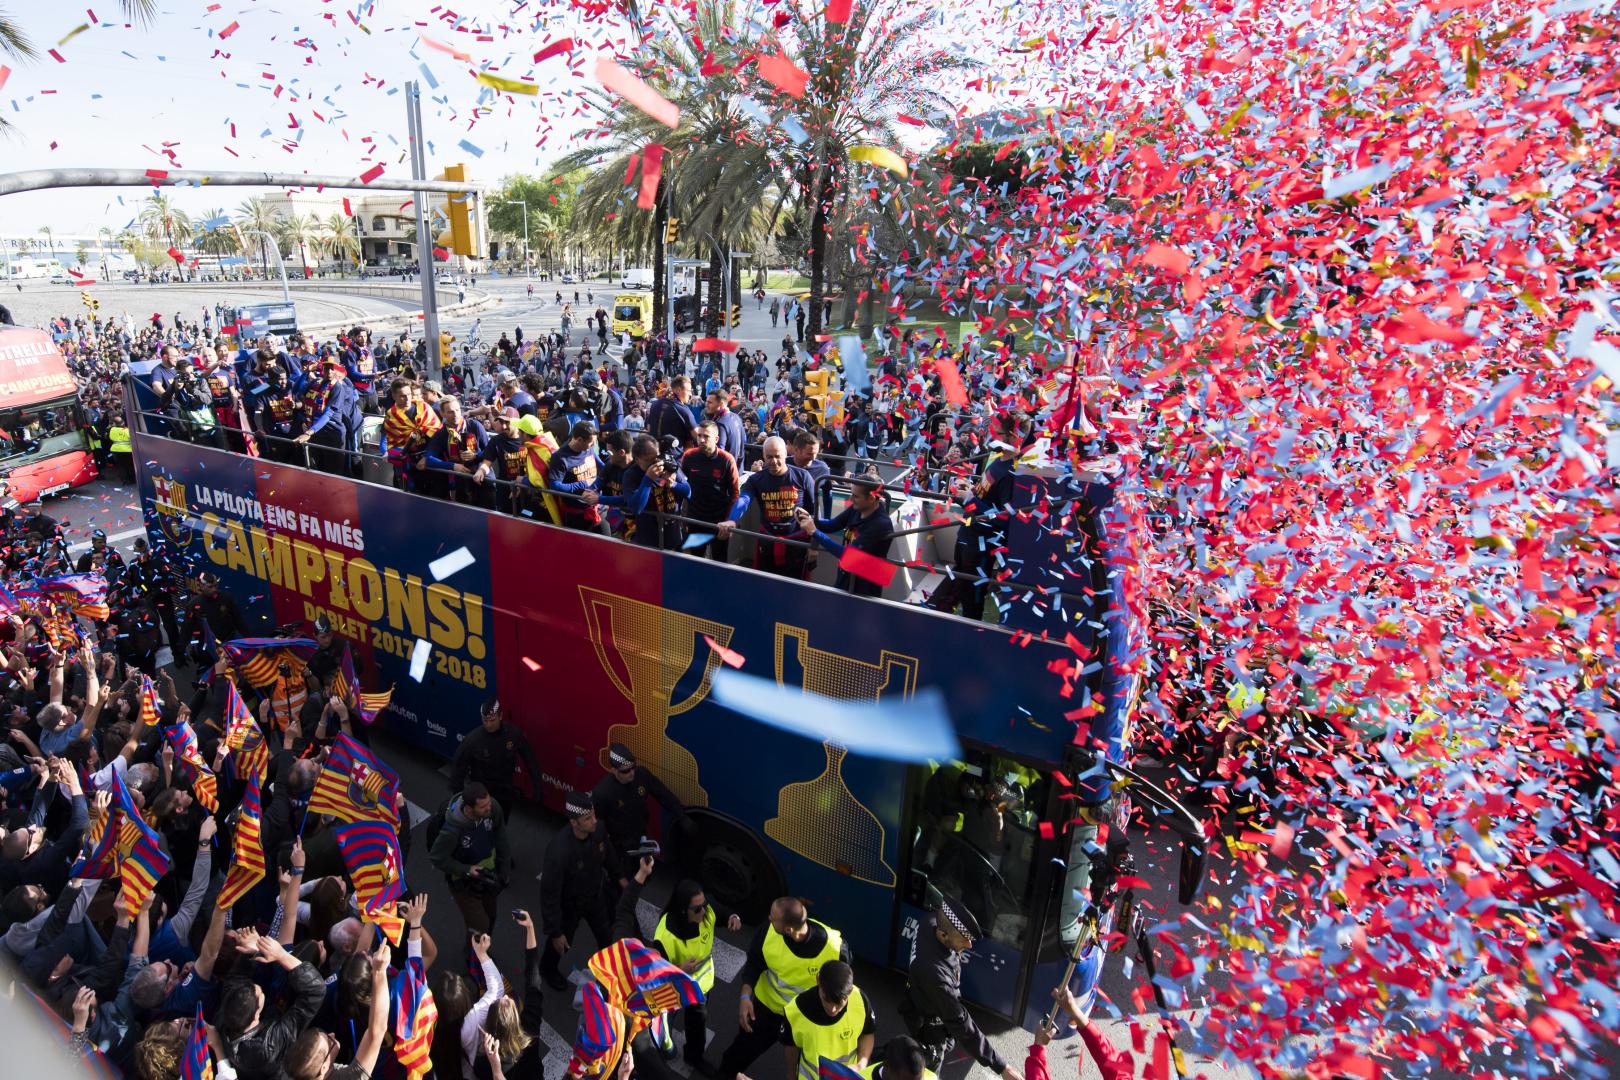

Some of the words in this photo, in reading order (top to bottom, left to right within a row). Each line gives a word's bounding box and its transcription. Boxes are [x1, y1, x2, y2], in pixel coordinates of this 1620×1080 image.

[761, 490, 799, 501] CAMPIONS
[765, 501, 775, 510] DE
[194, 484, 213, 507] LA
[214, 489, 265, 522] PILOTA
[265, 503, 297, 531] ENS
[299, 513, 322, 539] FA
[323, 518, 365, 551] MÉS
[201, 511, 487, 660] CAMPIONS!
[436, 654, 487, 689] 2018
[426, 719, 447, 736] beko
